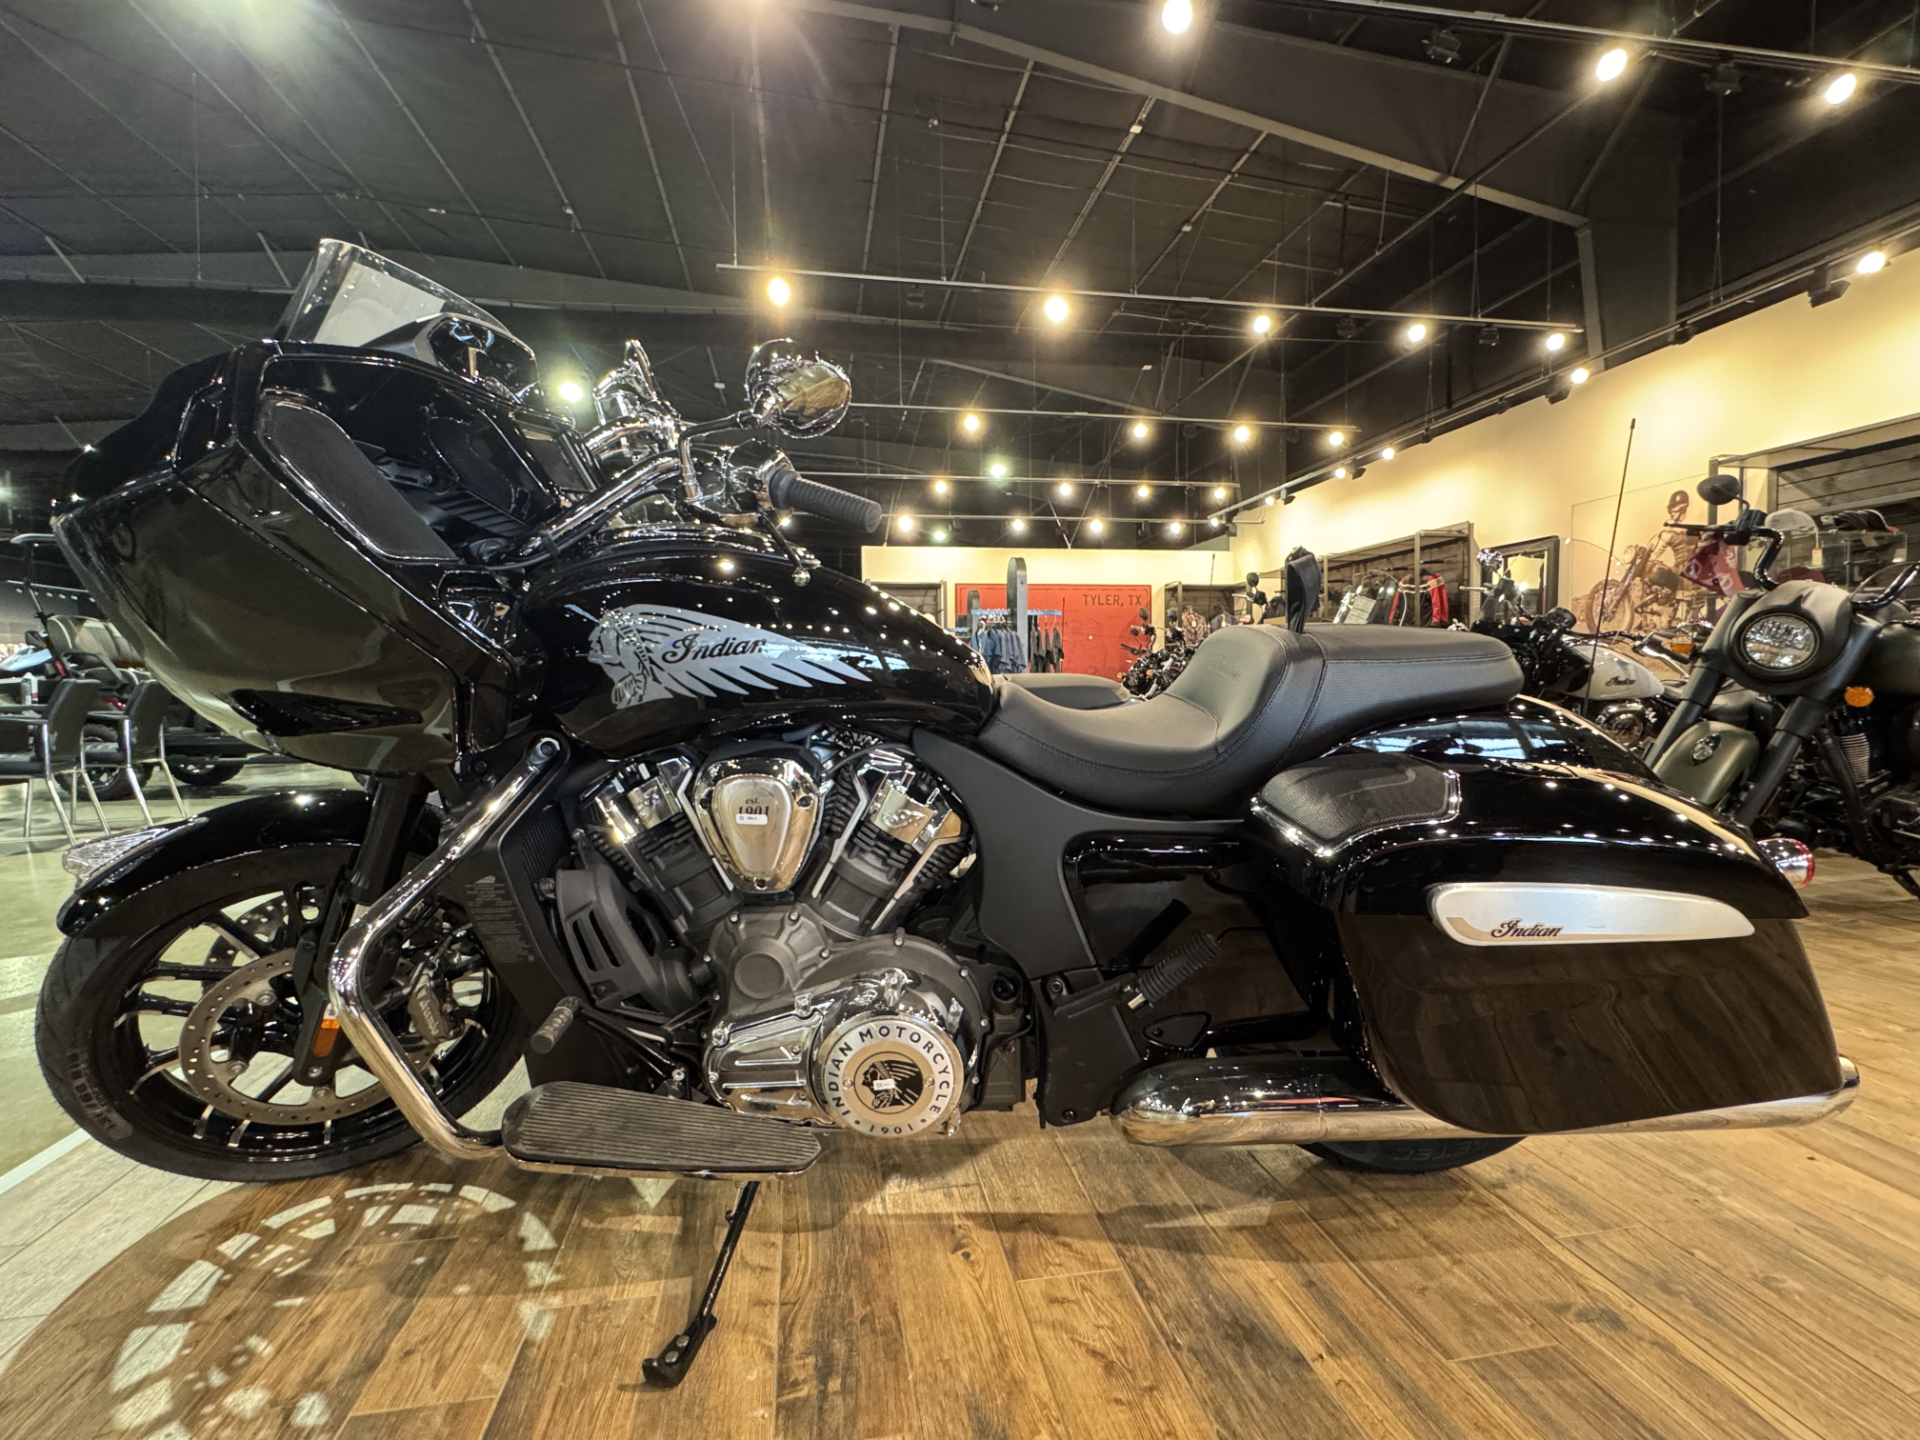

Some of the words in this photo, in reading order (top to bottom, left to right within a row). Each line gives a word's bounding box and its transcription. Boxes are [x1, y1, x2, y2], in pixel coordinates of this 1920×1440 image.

[1082, 594, 1124, 608] TYLER,
[1128, 594, 1142, 606] TX
[661, 633, 768, 664] Indian
[1490, 919, 1562, 938] Indian
[827, 1041, 853, 1117] INDIAN
[858, 1025, 951, 1115] MOTORCYCLE
[869, 1122, 914, 1135] 1901
